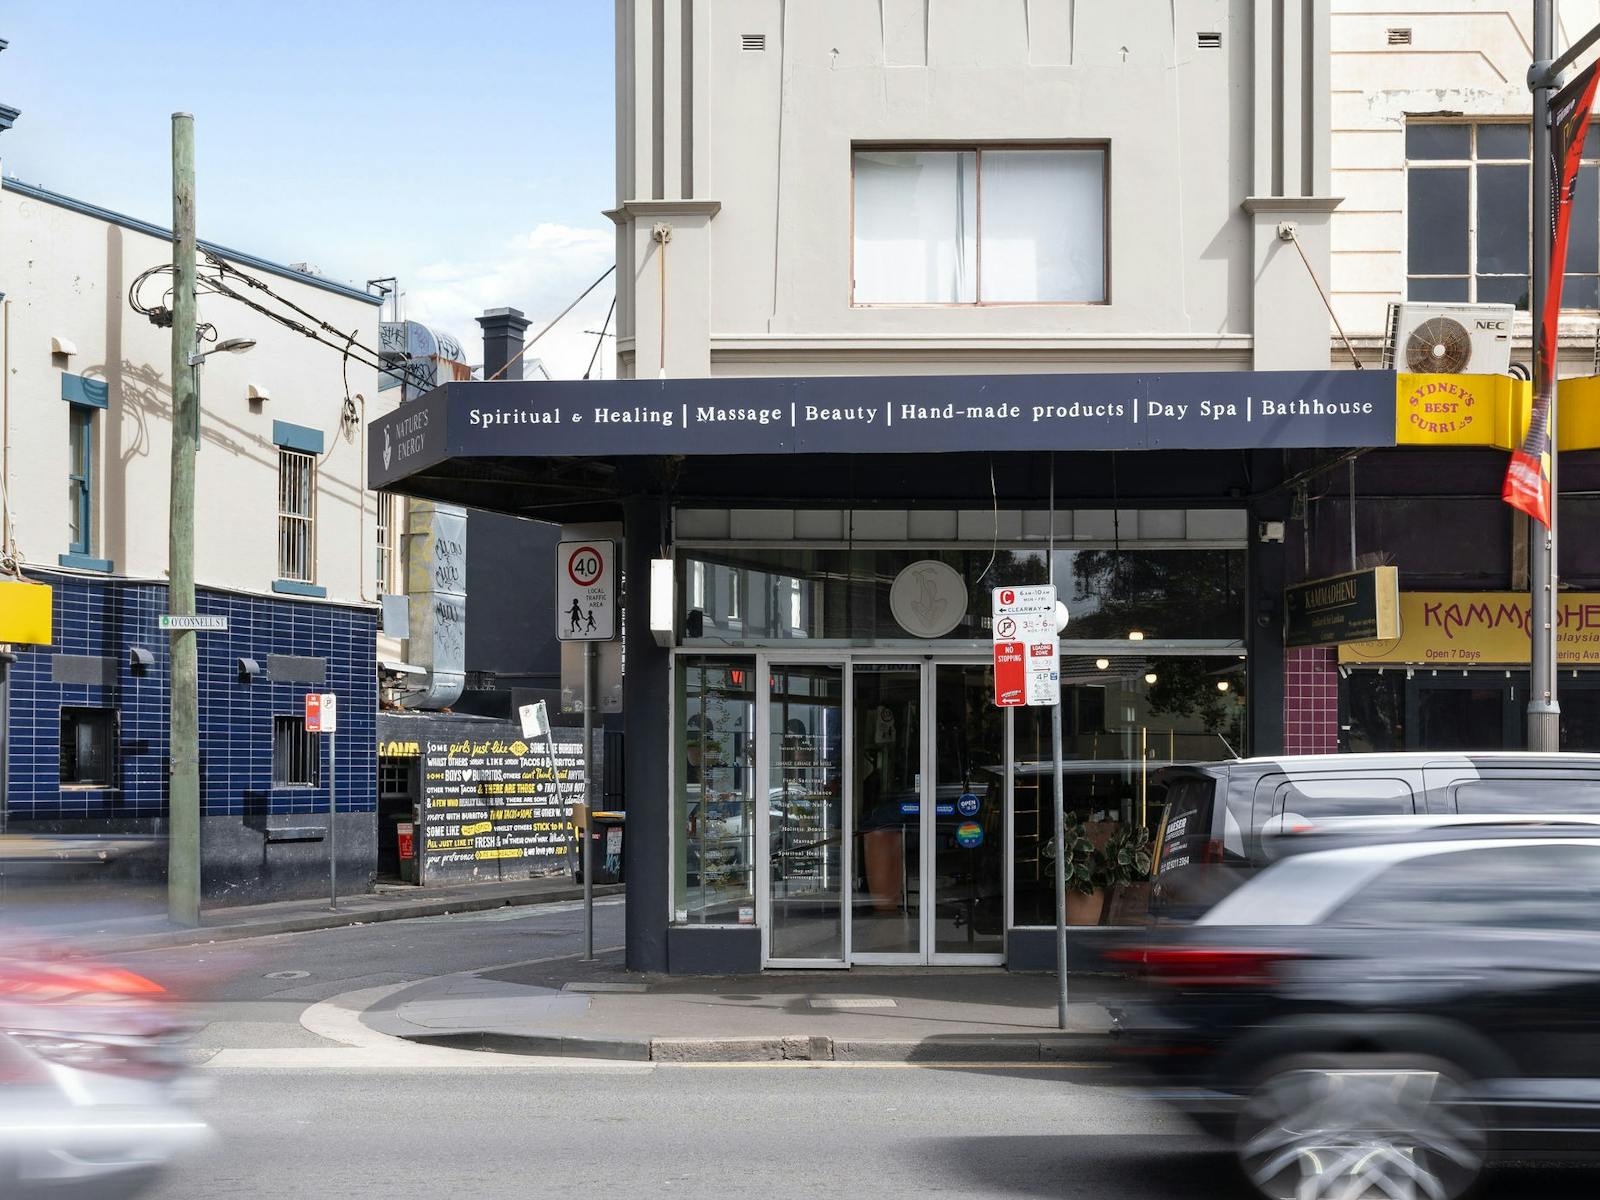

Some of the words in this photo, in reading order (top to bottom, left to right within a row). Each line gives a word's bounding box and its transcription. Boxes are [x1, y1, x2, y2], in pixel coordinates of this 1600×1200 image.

[1475, 321, 1505, 330] NEC
[1408, 382, 1475, 407] SYDNEY'S
[901, 402, 1021, 420] Hand-made
[1032, 401, 1124, 422] products
[1147, 401, 1189, 421] Day
[1200, 400, 1237, 421] Spa
[1261, 398, 1373, 416] Bathhouse
[1424, 403, 1459, 413] BEST
[469, 407, 561, 428] Spiritual
[571, 412, 584, 424] &
[594, 407, 674, 427] Healing
[695, 406, 782, 425] Massage
[805, 405, 878, 424] Beauty
[396, 409, 429, 440] NATURE'S
[398, 433, 426, 461] ENERGY
[574, 557, 598, 576] 40
[1002, 591, 1013, 604] C
[1005, 646, 1014, 654] NO
[1426, 649, 1449, 660] Open
[1451, 649, 1457, 658] 7
[1459, 649, 1481, 660] Days
[448, 740, 471, 759] girls
[471, 741, 491, 758] just
[490, 740, 509, 754] like
[529, 742, 546, 754] SOME
[427, 757, 447, 767] WHILST
[448, 757, 468, 767] OTHERS
[486, 757, 504, 766] LIKE
[445, 769, 462, 782] BOYS
[426, 786, 444, 794] OTHER
[484, 783, 504, 794] THERE
[504, 783, 516, 794] ARE
[516, 783, 536, 794] THOSE
[426, 797, 432, 809] &
[432, 799, 437, 807] A
[436, 799, 447, 807] FEW
[446, 799, 459, 807] WHO
[960, 799, 976, 808] OPEN
[427, 813, 445, 821] more
[446, 812, 461, 820] WITH
[461, 811, 488, 820] BURRITOS
[426, 825, 445, 837] SOME
[445, 825, 460, 836] LIKE
[532, 822, 550, 831] STICK
[551, 822, 558, 830] to
[438, 839, 454, 848] JUST
[454, 839, 466, 847] LIKE
[467, 838, 474, 846] IT
[474, 836, 495, 848] FRESH
